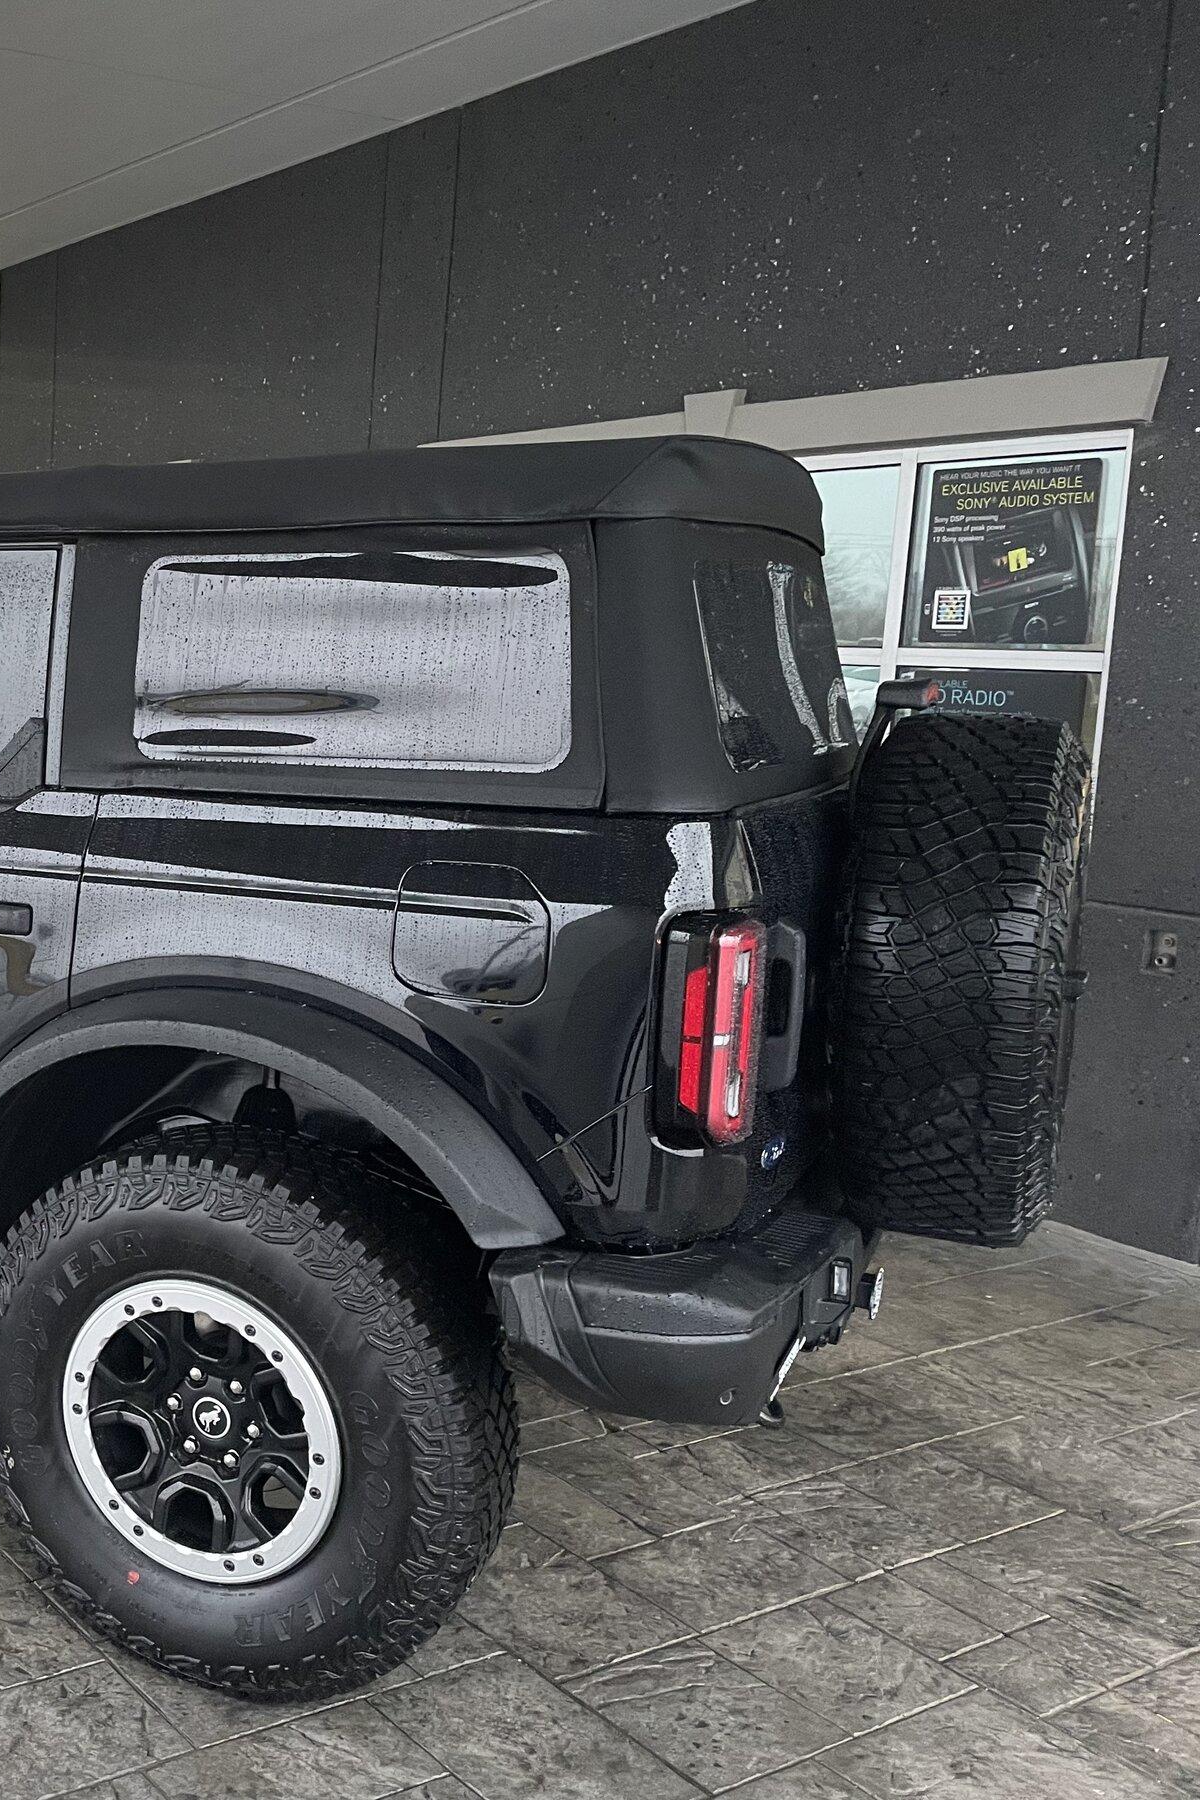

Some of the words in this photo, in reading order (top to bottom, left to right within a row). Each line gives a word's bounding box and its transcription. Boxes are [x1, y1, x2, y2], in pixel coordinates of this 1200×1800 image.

[940, 473, 959, 481] HEAR
[960, 471, 980, 479] YOUR
[980, 470, 1003, 478] MUSIC
[1004, 469, 1018, 477] THE
[1052, 465, 1073, 473] WANT
[1074, 464, 1081, 472] IT
[942, 480, 1009, 496] EXCLUSIVE
[1011, 476, 1083, 492] AVAILABLE
[998, 495, 1039, 508] AUDIO
[1042, 491, 1094, 506] SYSTEM
[934, 516, 949, 524] Sony
[986, 524, 1006, 532] power
[957, 535, 984, 543] speakers
